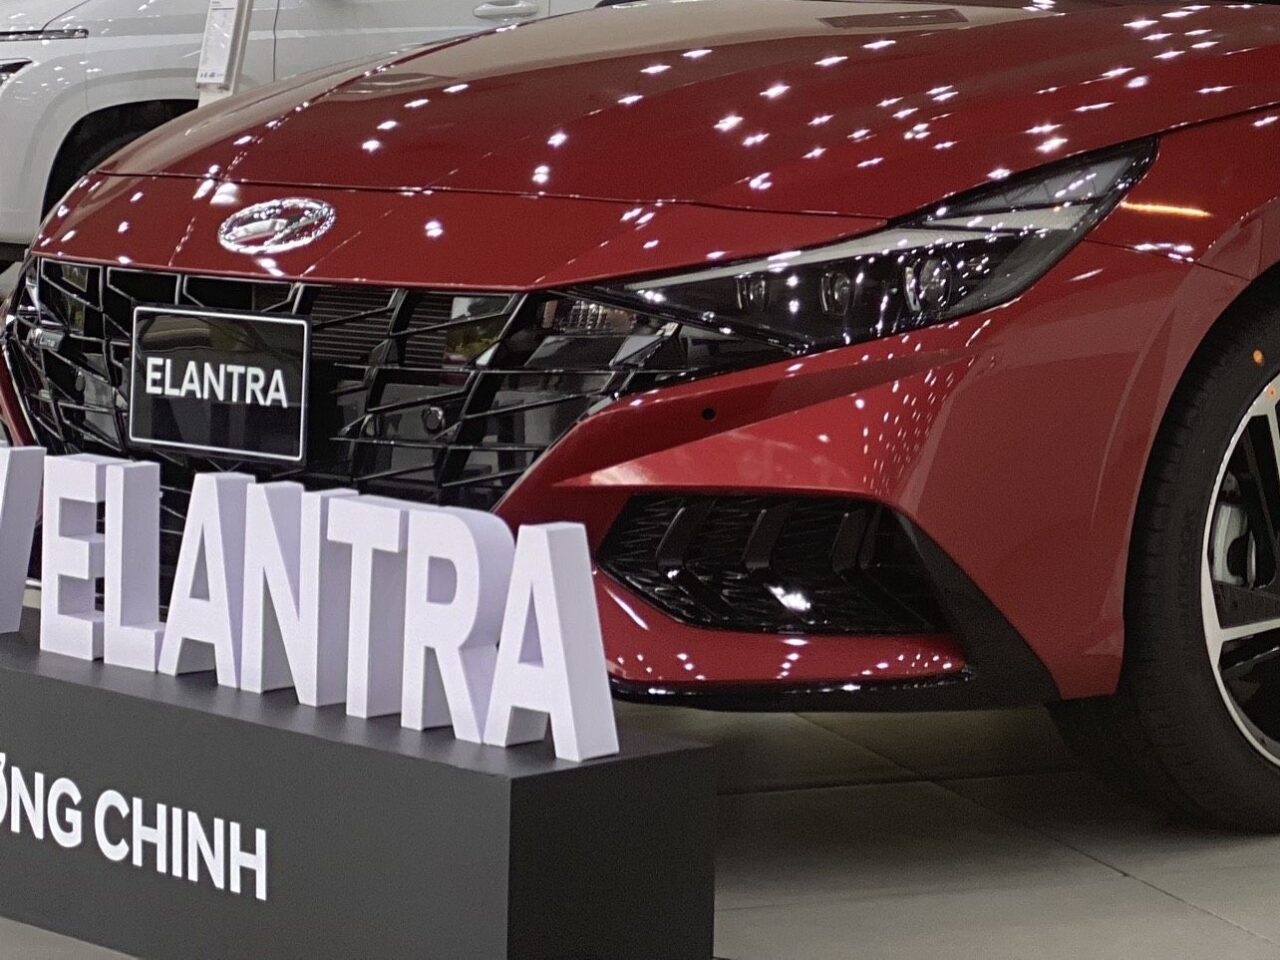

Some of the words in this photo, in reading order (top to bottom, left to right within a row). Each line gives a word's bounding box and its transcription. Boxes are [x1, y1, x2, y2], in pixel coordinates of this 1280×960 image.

[145, 356, 288, 409] ELANTRA
[40, 453, 620, 762] ELANTRA
[0, 752, 83, 848] NG
[94, 789, 267, 901] CHINH
